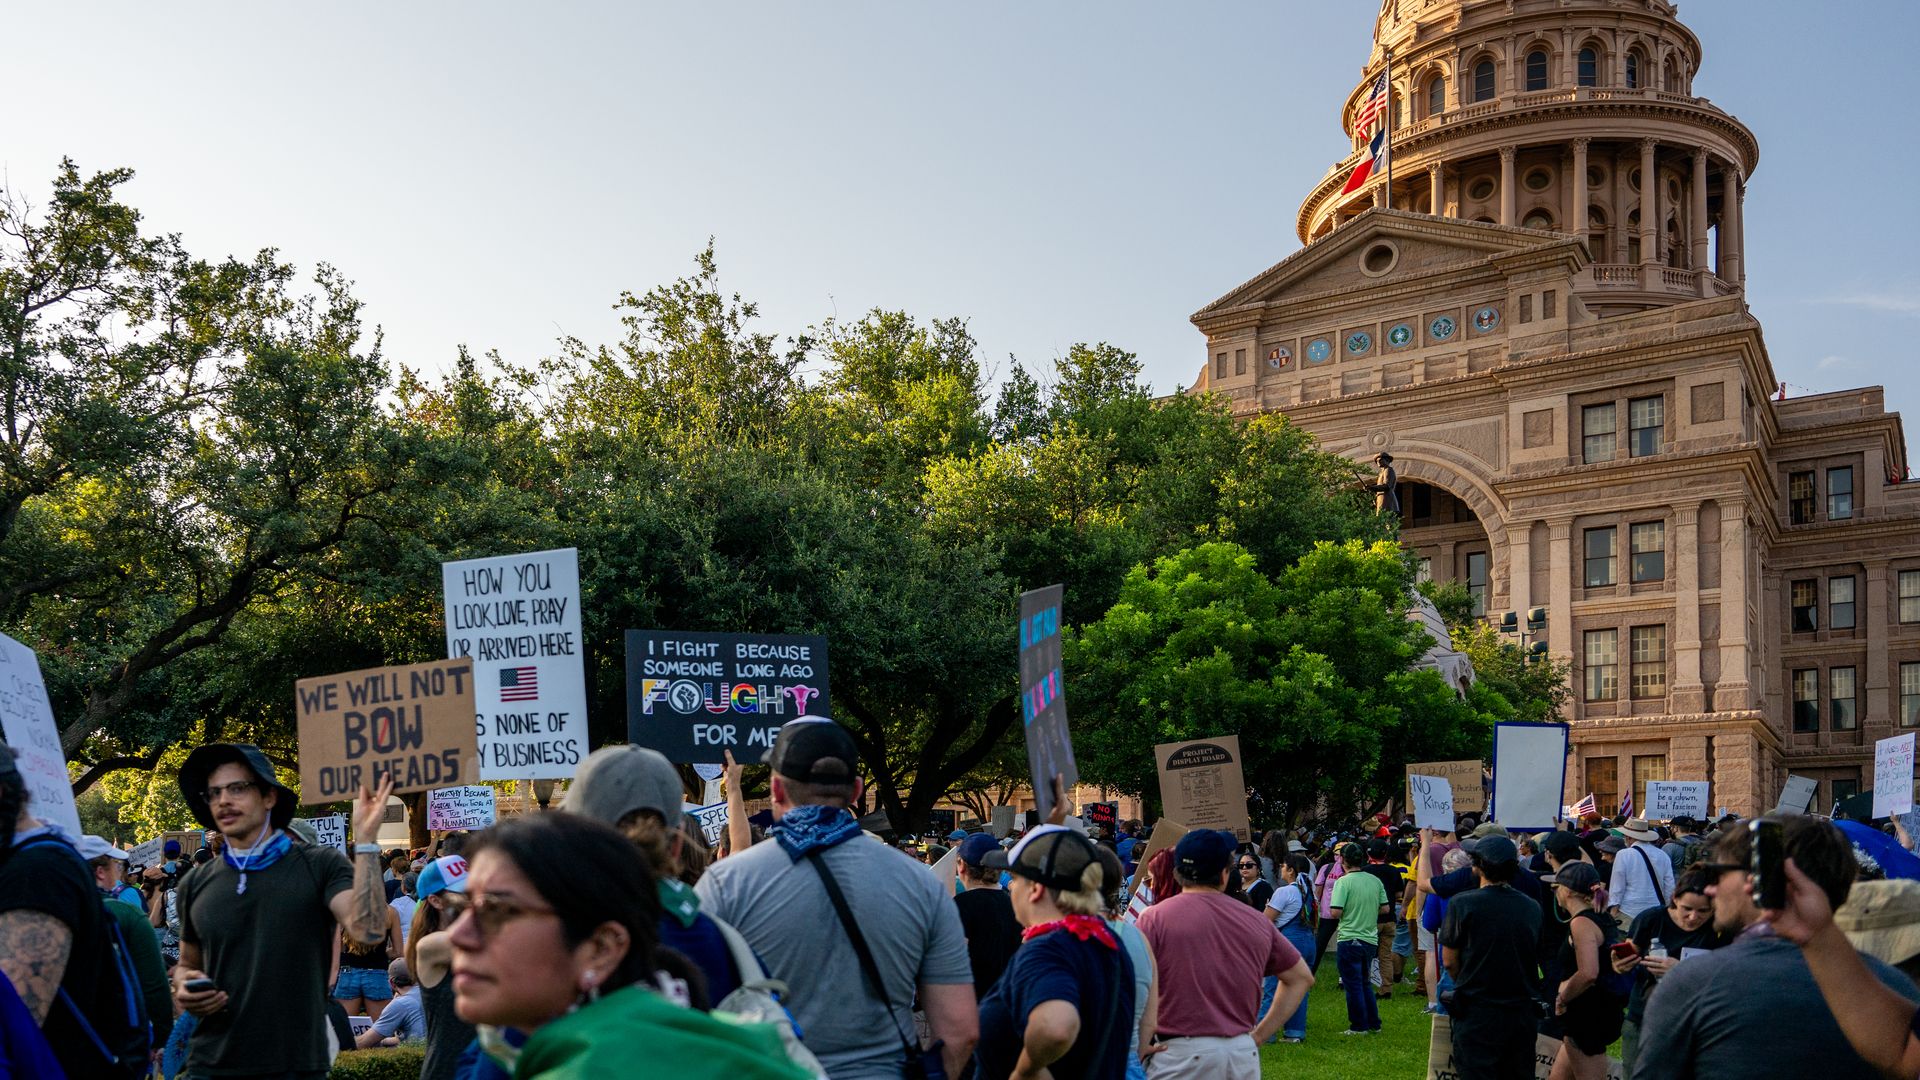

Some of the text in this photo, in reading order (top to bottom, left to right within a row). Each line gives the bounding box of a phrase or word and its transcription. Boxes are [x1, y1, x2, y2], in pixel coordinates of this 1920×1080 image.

[463, 563, 552, 597] HOW YOU
[532, 597, 568, 626] PRAY
[453, 632, 575, 662] OR ARRIVED HERE
[648, 640, 811, 661] I FIGHT BECAUSE
[643, 659, 814, 678] SOMEONE LONG AGO
[299, 666, 471, 715] WE WILL NOT
[641, 678, 820, 715] FOUGHT
[344, 703, 424, 760] BOW
[475, 711, 570, 736] S NONE OF
[693, 724, 782, 748] FOR ME
[477, 739, 580, 769] Y BUSINESS
[1172, 753, 1226, 766] DISPLAY BOARD
[1182, 748, 1213, 758] PROJECT
[319, 748, 461, 796] OUR HEADS
[1449, 763, 1475, 775] Police
[464, 786, 490, 798] BECAME
[1412, 776, 1431, 795] NO
[1654, 783, 1677, 793] Trump
[1423, 795, 1450, 815] Kings
[1657, 793, 1666, 801] be
[1657, 802, 1697, 811] but fascism
[701, 805, 729, 828] SPEC
[1097, 804, 1111, 814] NO
[310, 817, 339, 832] FUL
[442, 816, 481, 828] HUMANITY
[320, 832, 334, 844] ST
[447, 861, 469, 878] US
